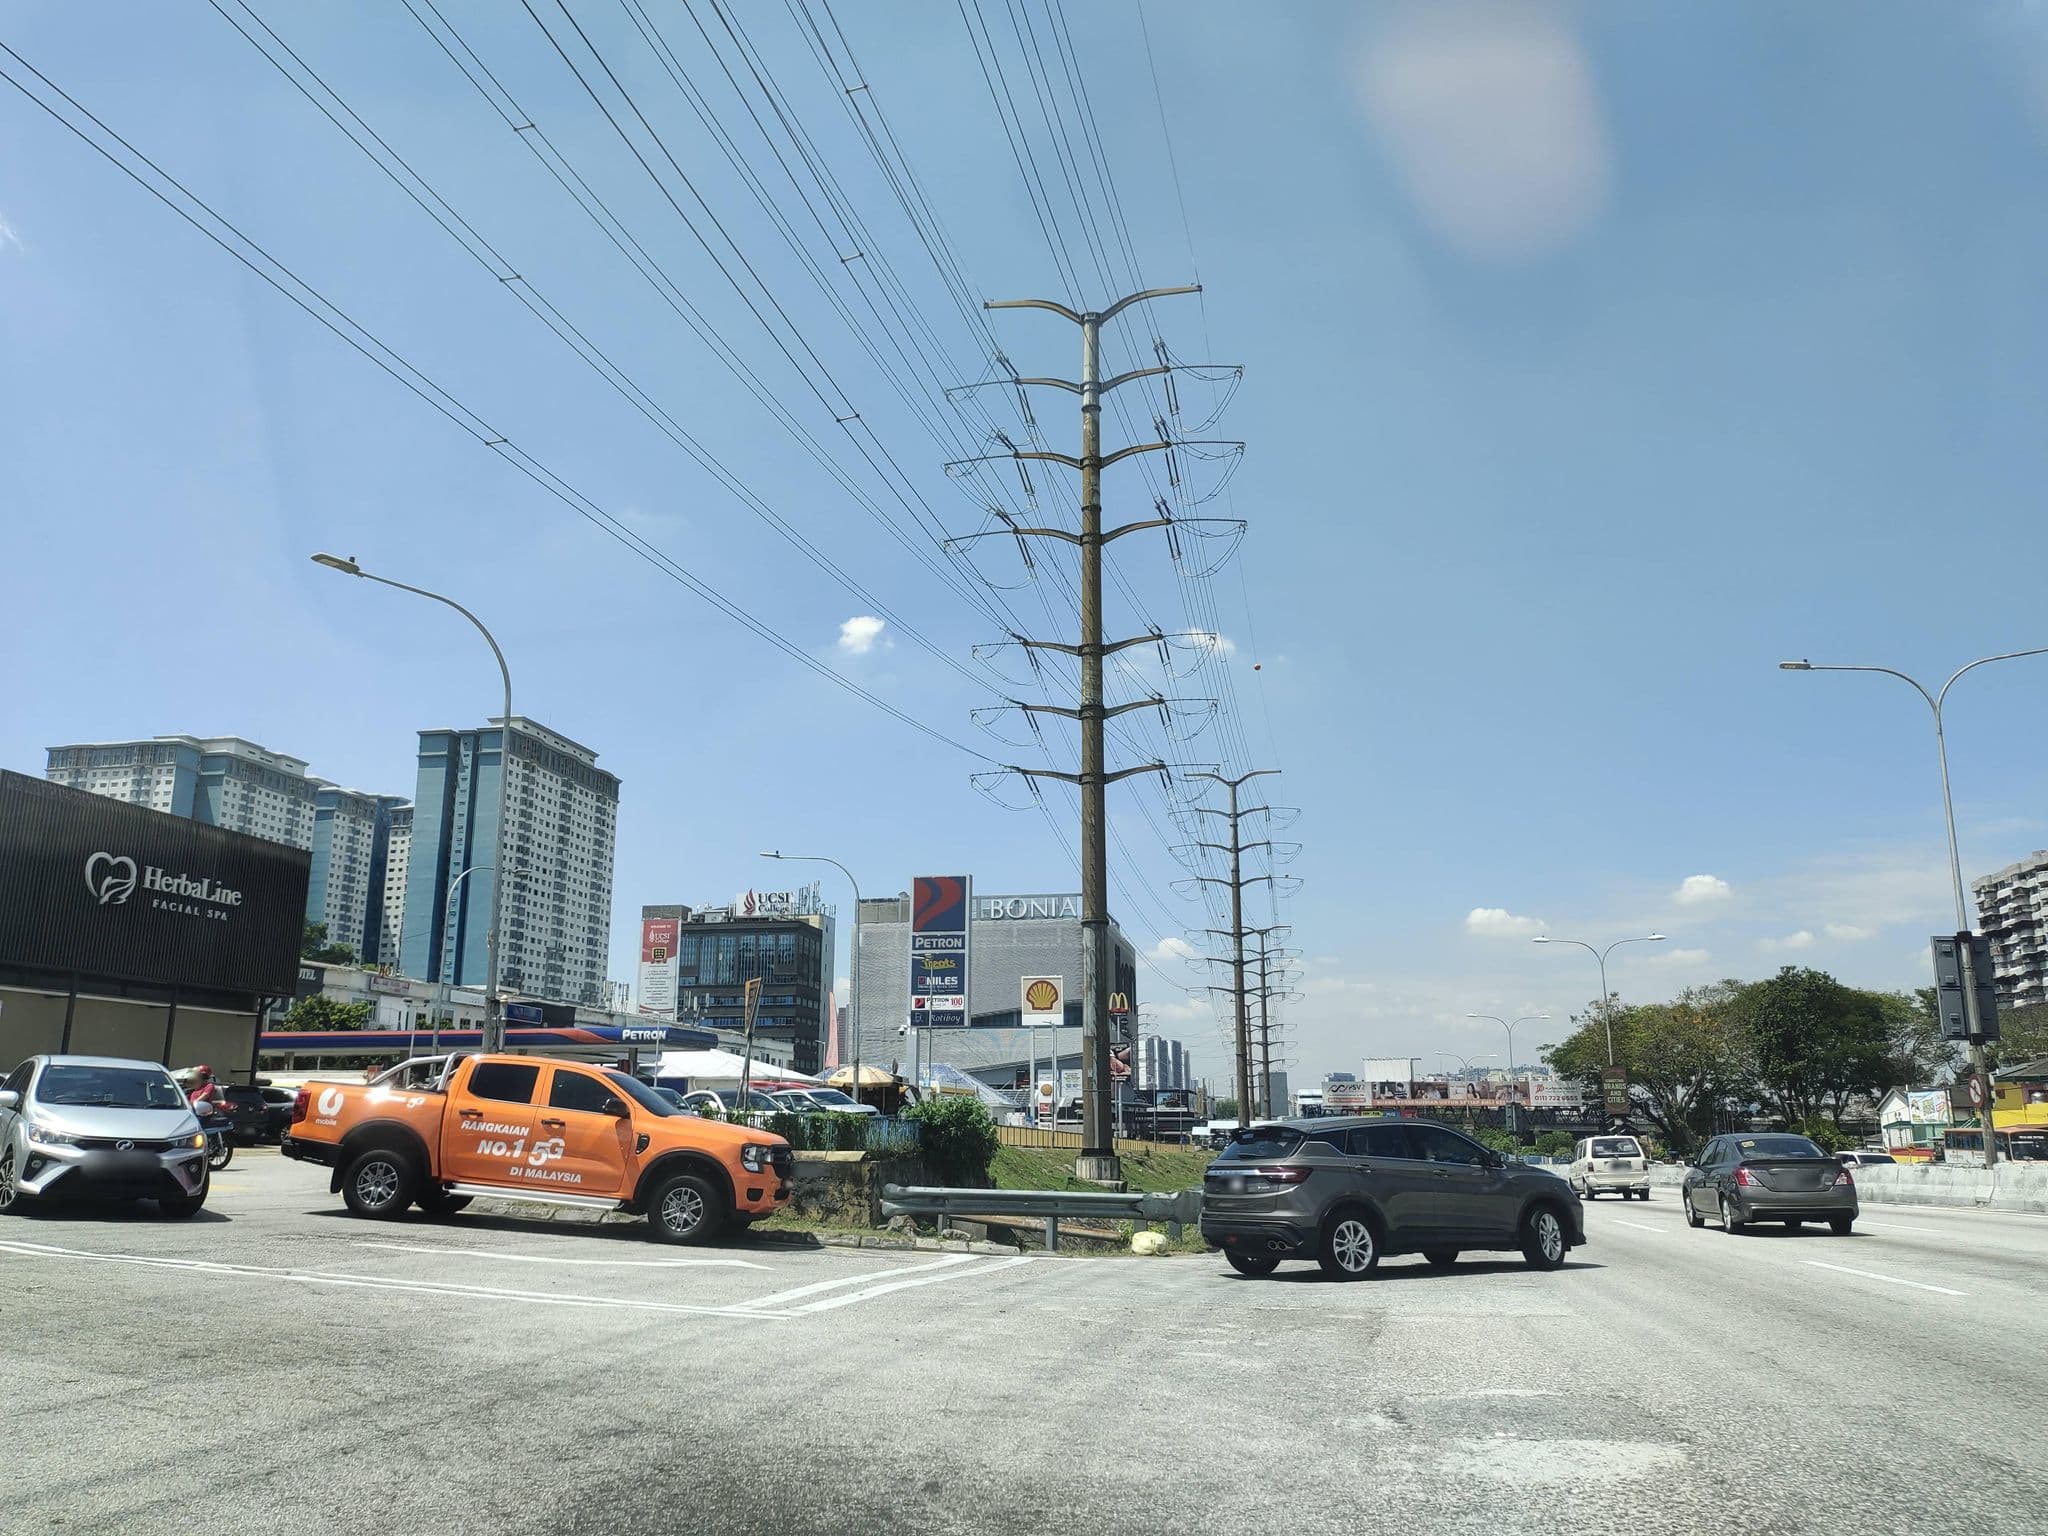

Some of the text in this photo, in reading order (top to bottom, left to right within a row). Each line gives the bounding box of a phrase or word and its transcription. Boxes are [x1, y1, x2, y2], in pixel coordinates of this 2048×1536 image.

[142, 865, 242, 906] HerbaLine
[758, 892, 790, 904] UCSI
[152, 898, 228, 921] FACIAL SPA
[758, 904, 790, 914] College
[990, 897, 1078, 919] BONIA
[951, 997, 963, 1006] 100
[315, 1117, 337, 1126] mobile
[461, 1120, 530, 1137] RANGKAIAN
[476, 1137, 566, 1167] NO.1 5G
[509, 1166, 582, 1184] DI MALAYSIA
